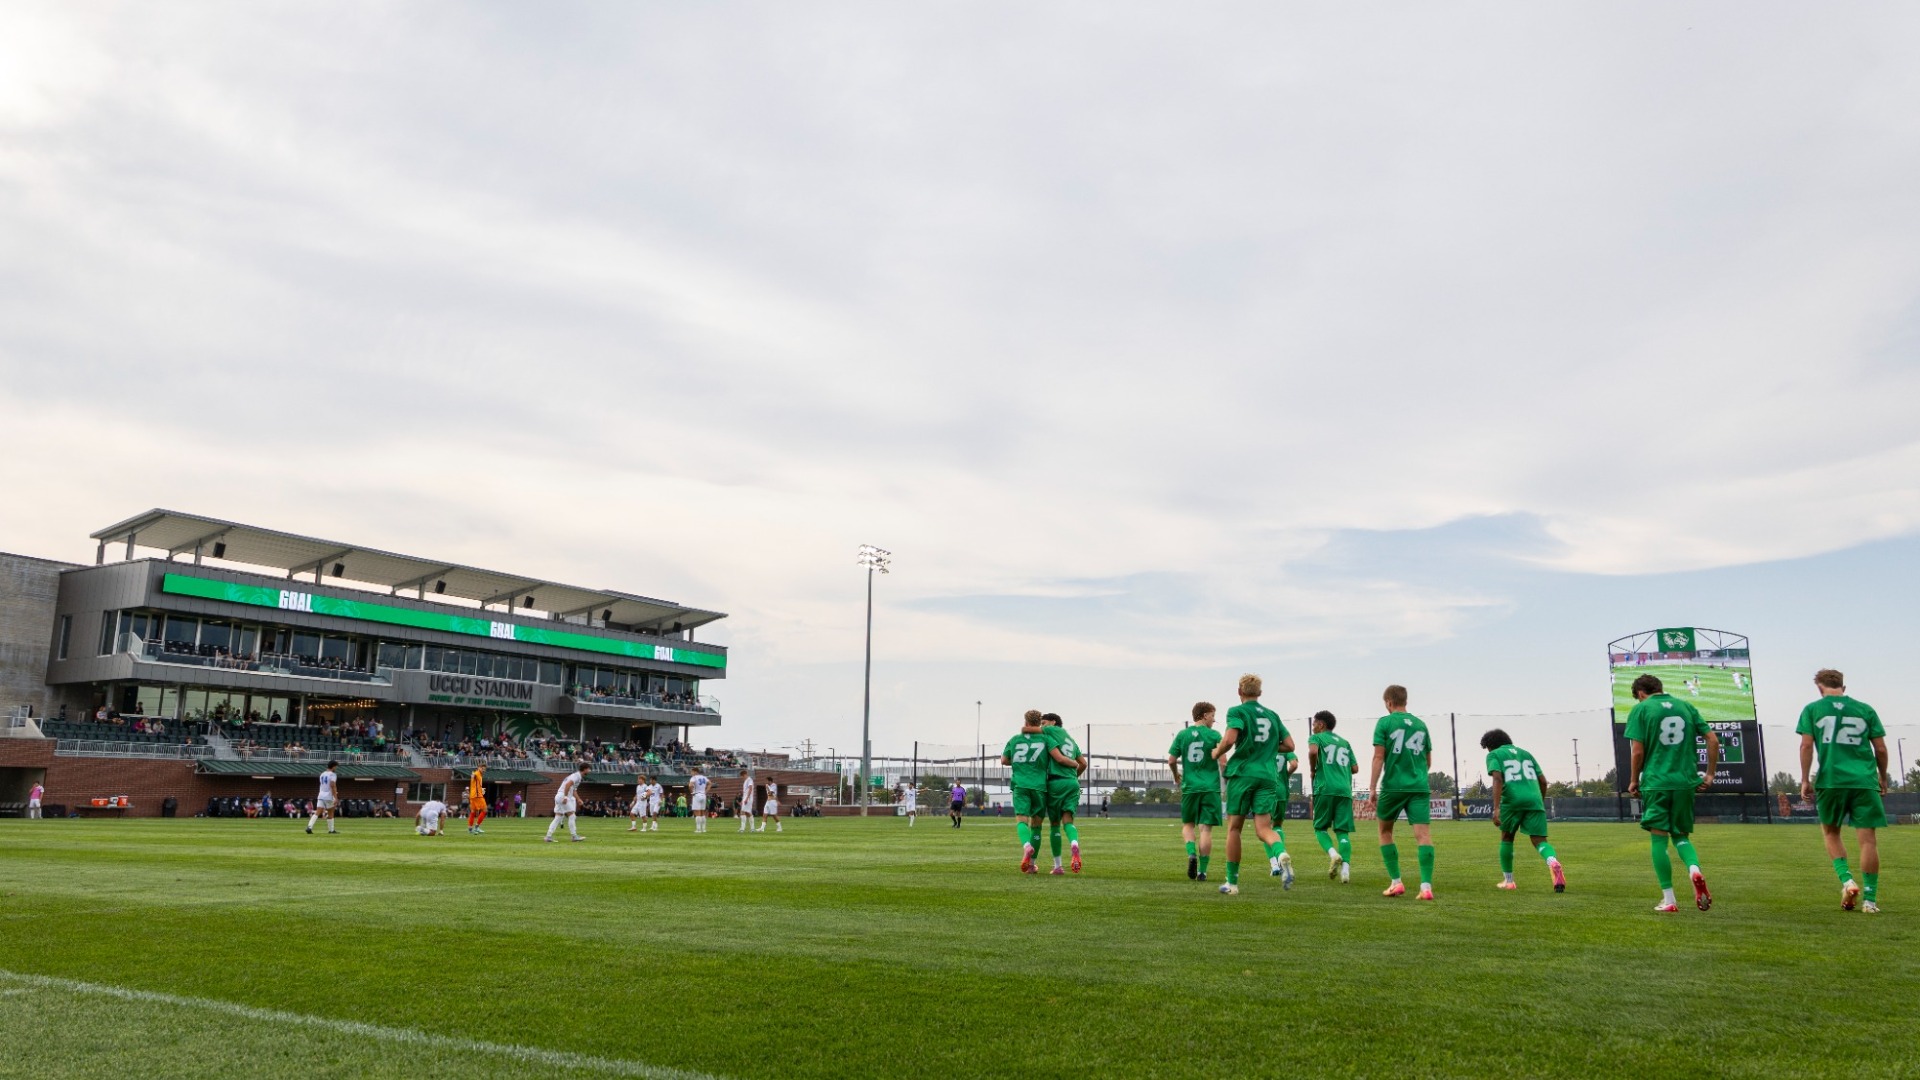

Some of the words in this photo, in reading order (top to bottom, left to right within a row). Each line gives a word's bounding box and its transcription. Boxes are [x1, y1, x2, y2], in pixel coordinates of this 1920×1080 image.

[279, 590, 313, 613] GOAL
[490, 622, 516, 640] GOAL
[654, 646, 674, 662] GOAL
[430, 674, 471, 694] UCCU
[474, 680, 533, 700] STADIUM
[1254, 718, 1271, 742] 3
[1659, 716, 1685, 746] 8
[1708, 722, 1742, 730] PEPSI
[1815, 715, 1867, 746] 12
[1013, 742, 1045, 763] 27
[1061, 738, 1074, 757] 2
[1187, 741, 1204, 763] 6
[1389, 728, 1426, 756] 14
[1324, 743, 1350, 767] 16
[1504, 759, 1538, 782] 26
[1712, 777, 1743, 785] control
[1467, 803, 1492, 815] Carl's
